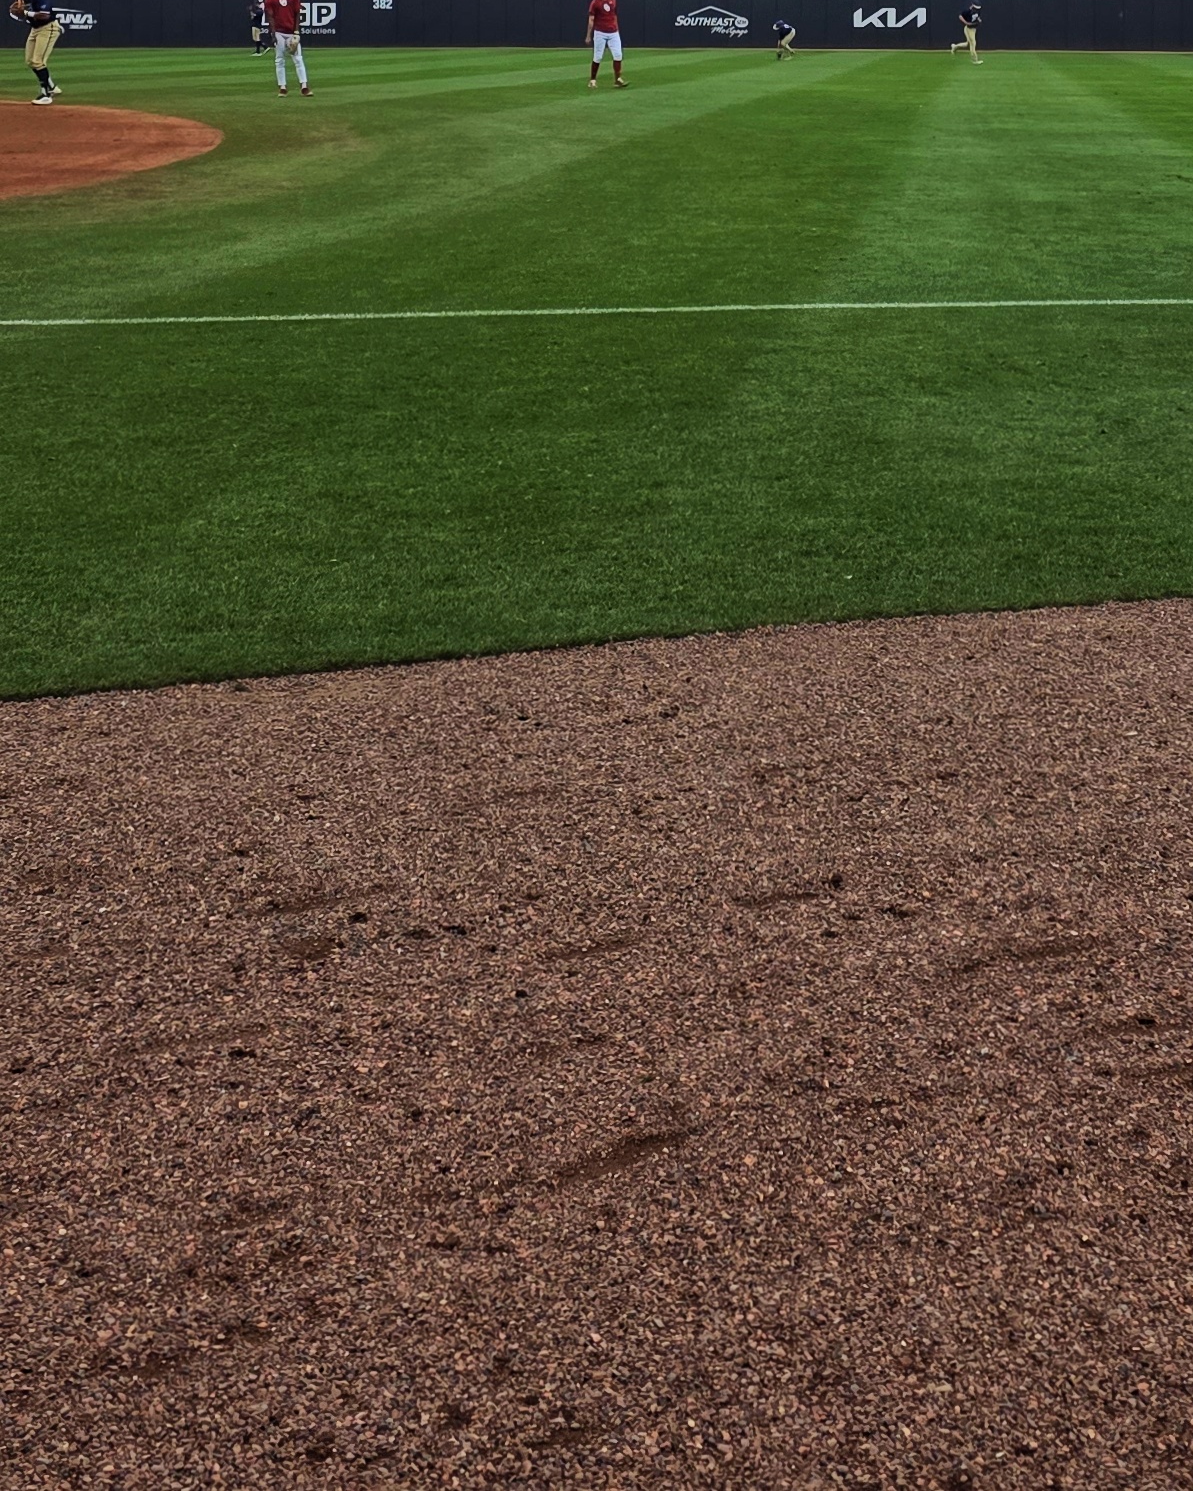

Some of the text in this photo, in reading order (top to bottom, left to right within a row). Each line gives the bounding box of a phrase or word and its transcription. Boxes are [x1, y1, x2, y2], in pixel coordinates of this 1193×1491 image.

[674, 14, 735, 27] SOUTHEAST
[853, 7, 927, 28] KIA
[300, 27, 336, 35] Solutions
